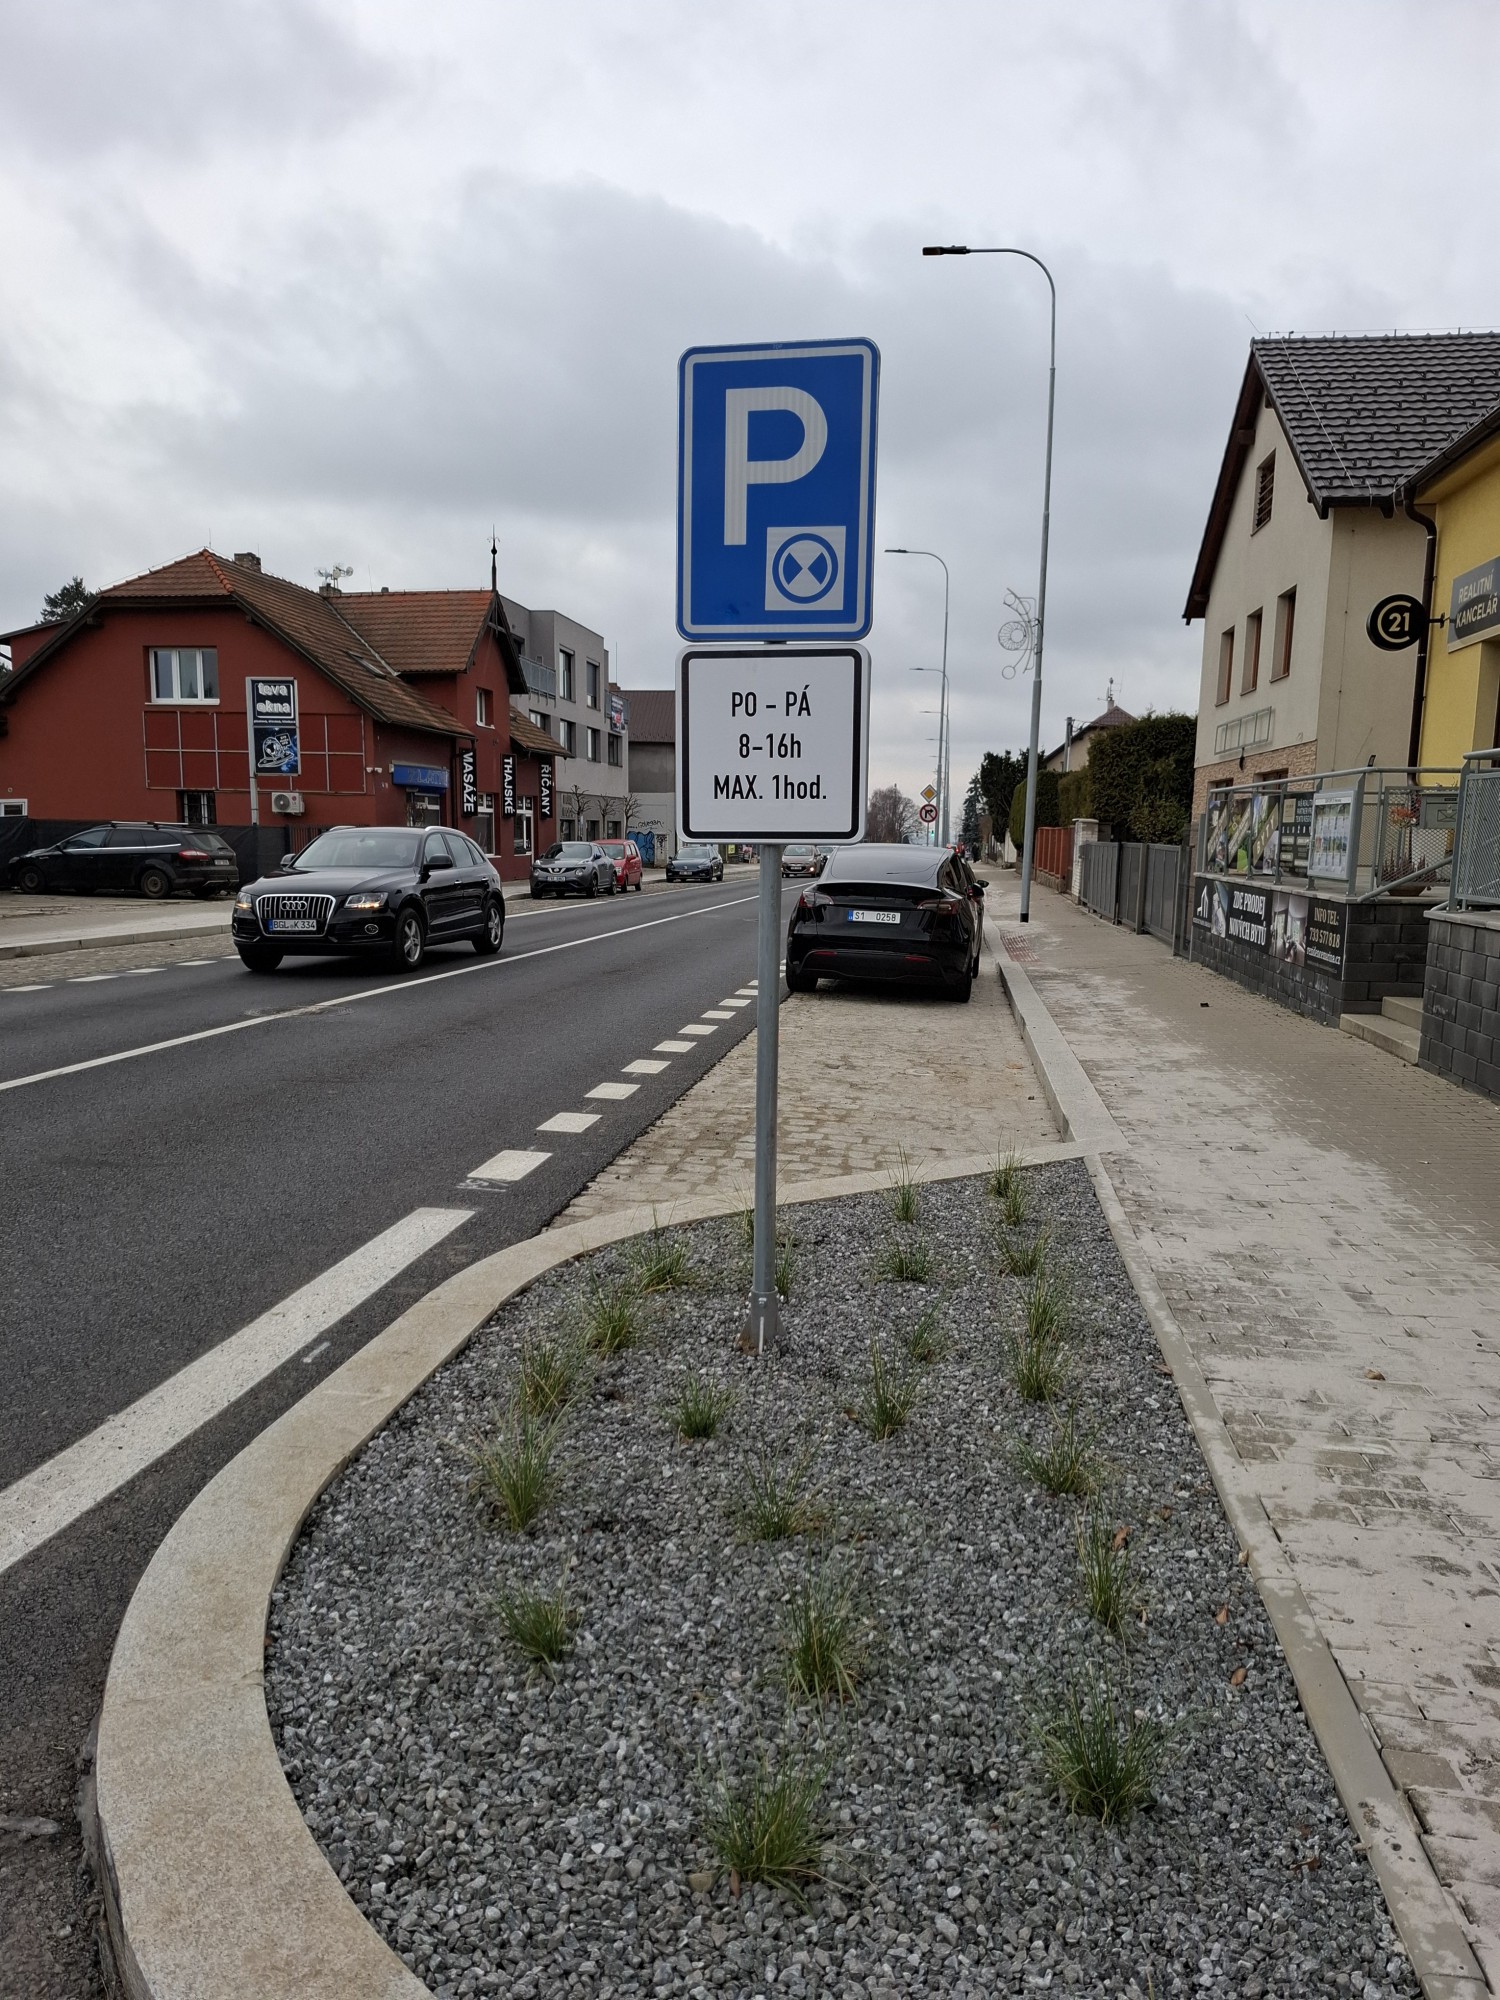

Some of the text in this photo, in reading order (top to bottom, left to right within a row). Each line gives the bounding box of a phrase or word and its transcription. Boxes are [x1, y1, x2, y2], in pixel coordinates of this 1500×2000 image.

[724, 386, 828, 546] P
[1458, 568, 1495, 604] REALITNÍ
[1455, 592, 1498, 628] KANCELÁŘ
[257, 682, 288, 696] teva
[731, 691, 757, 717] PO
[785, 684, 812, 717] PÁ
[256, 700, 291, 713] okna
[739, 733, 801, 759] 8-16h
[462, 751, 477, 813] MASÁŽE
[503, 756, 515, 814] THAJSKÉ
[541, 764, 552, 815] ŘÍČANY
[713, 774, 827, 800] MAX. 1hod.
[1233, 891, 1266, 920] ZDE PRODEJ
[1314, 907, 1339, 926] INFO TEL:
[273, 920, 316, 929] BGL K 334
[1228, 915, 1249, 941] NOVÝCH
[1250, 921, 1267, 946] BYTŮ
[1328, 932, 1341, 948] 818
